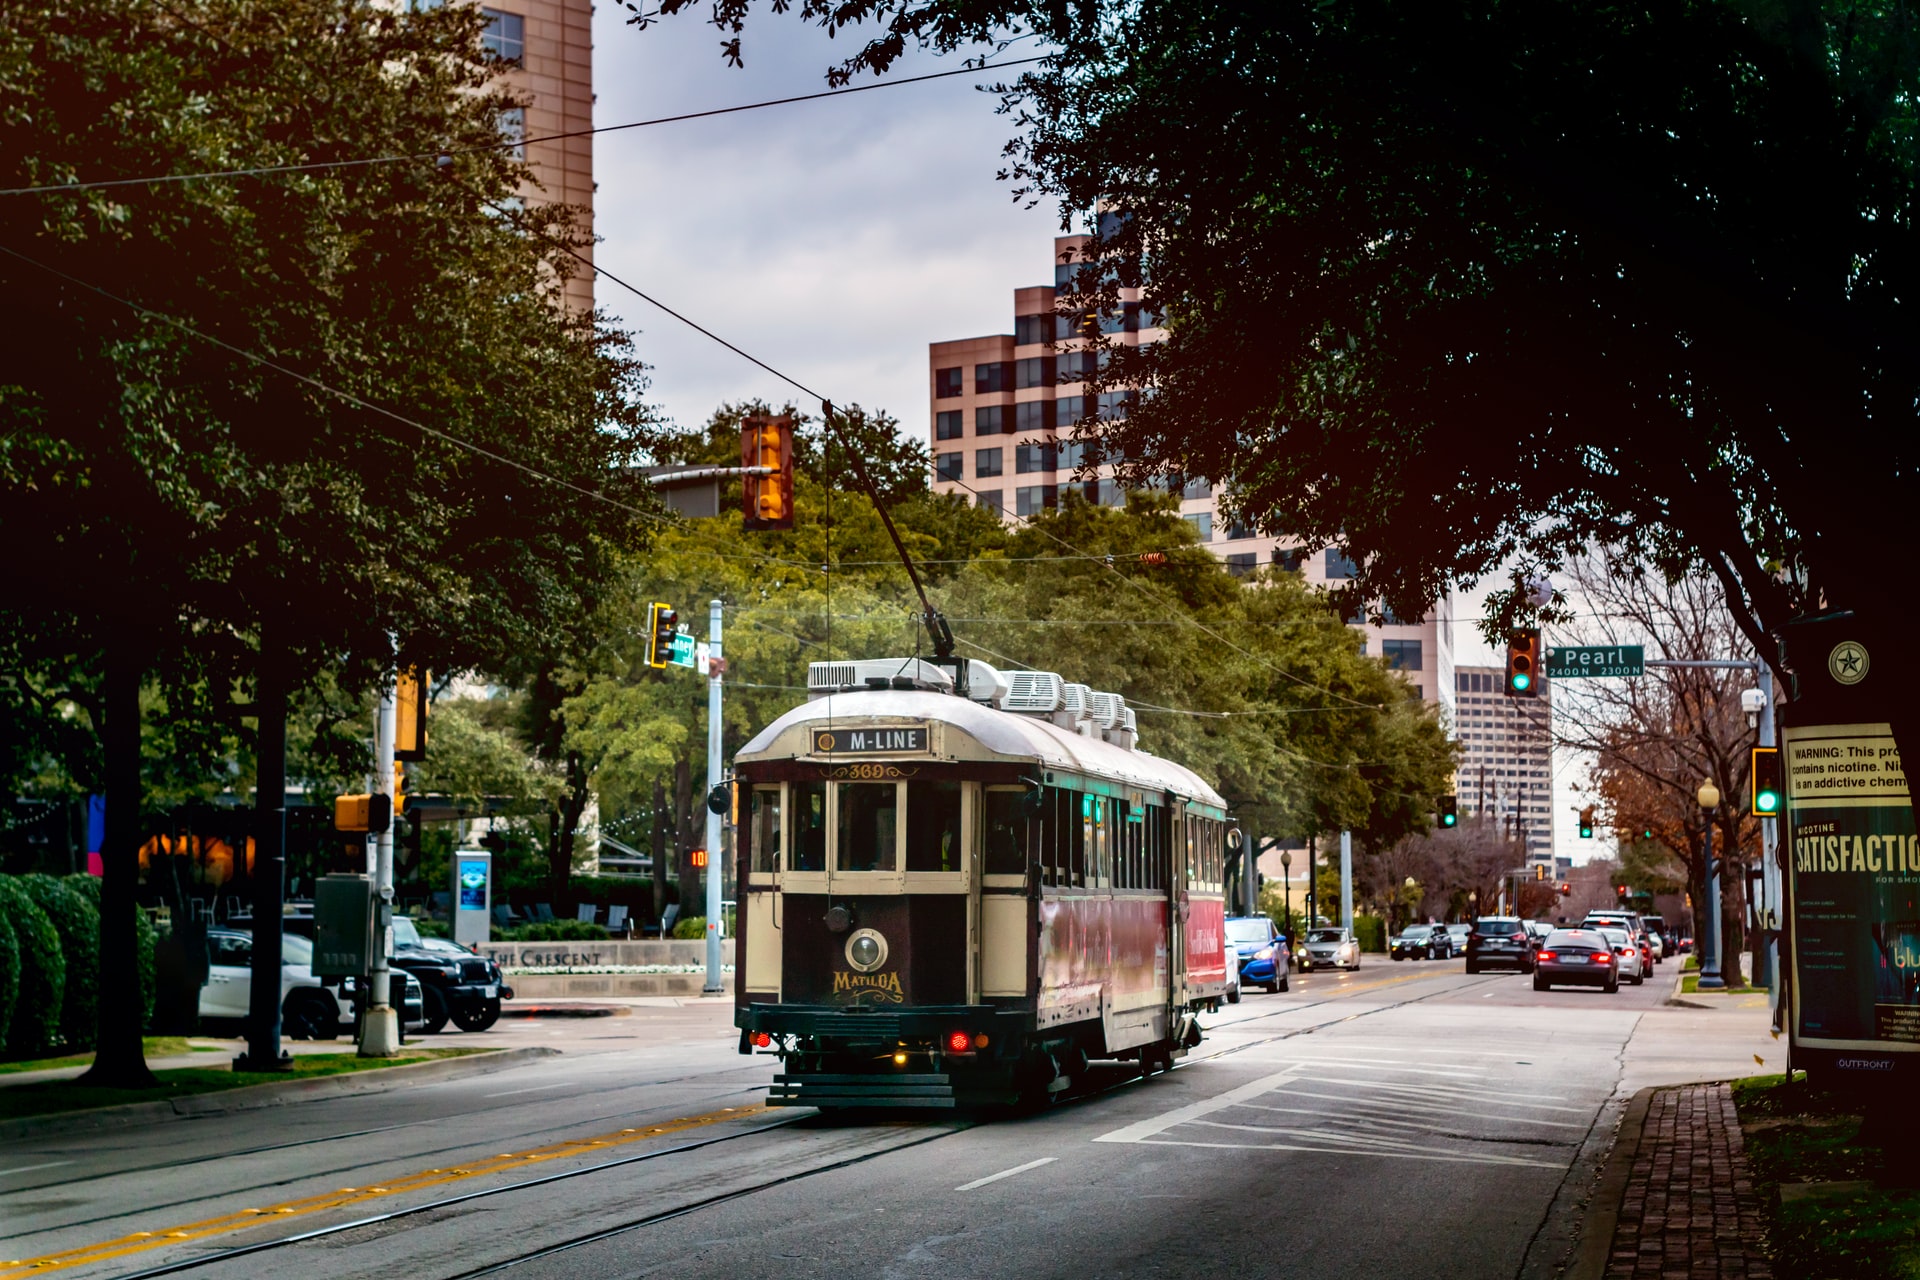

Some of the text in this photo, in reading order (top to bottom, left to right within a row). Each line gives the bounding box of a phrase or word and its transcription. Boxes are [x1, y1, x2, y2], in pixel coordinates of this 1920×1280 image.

[1565, 648, 1625, 666] Pearl
[1550, 666, 1641, 677] 2400 N 2300 N
[850, 730, 918, 750] M-LINE
[1795, 746, 1844, 760] WARNING:
[1847, 746, 1875, 758] This
[850, 763, 884, 779] 369
[1793, 763, 1825, 775] contains
[1828, 761, 1880, 773] nicotine.
[1796, 778, 1801, 789] is
[1803, 779, 1812, 789] an
[1815, 776, 1866, 789] addictive
[1798, 823, 1835, 836] NICOTINE
[1875, 876, 1894, 884] FOR
[488, 950, 601, 967] THE CRESCENT
[832, 971, 905, 995] MATILDA
